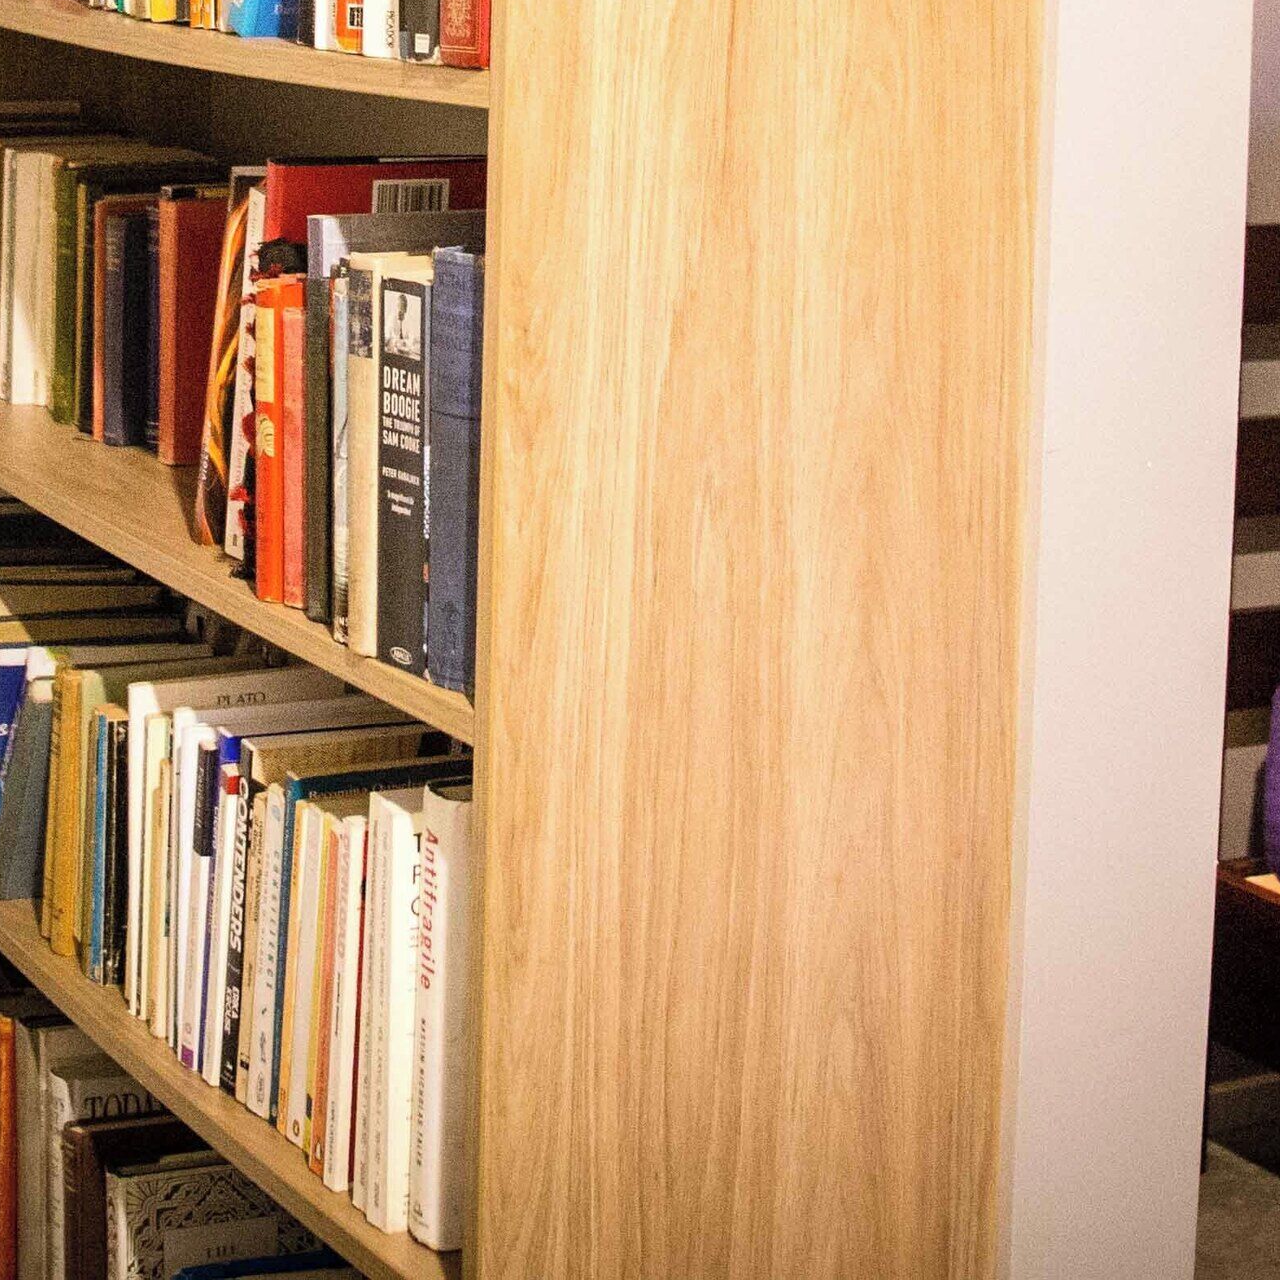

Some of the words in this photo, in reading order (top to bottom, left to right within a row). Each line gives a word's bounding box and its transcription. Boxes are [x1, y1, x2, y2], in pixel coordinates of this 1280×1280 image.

[384, 10, 394, 48] PICADOR
[383, 365, 420, 397] DREAM
[383, 391, 420, 423] BOOGIE
[382, 429, 399, 447] SAM
[400, 433, 420, 454] COOKE
[216, 691, 266, 708] PLATO
[194, 767, 204, 828] Foucault
[230, 775, 249, 953] CONTENDERS
[420, 828, 439, 990] Antifragile
[231, 985, 239, 1019] ERIKA
[417, 1068, 425, 1125] NICHOLAS
